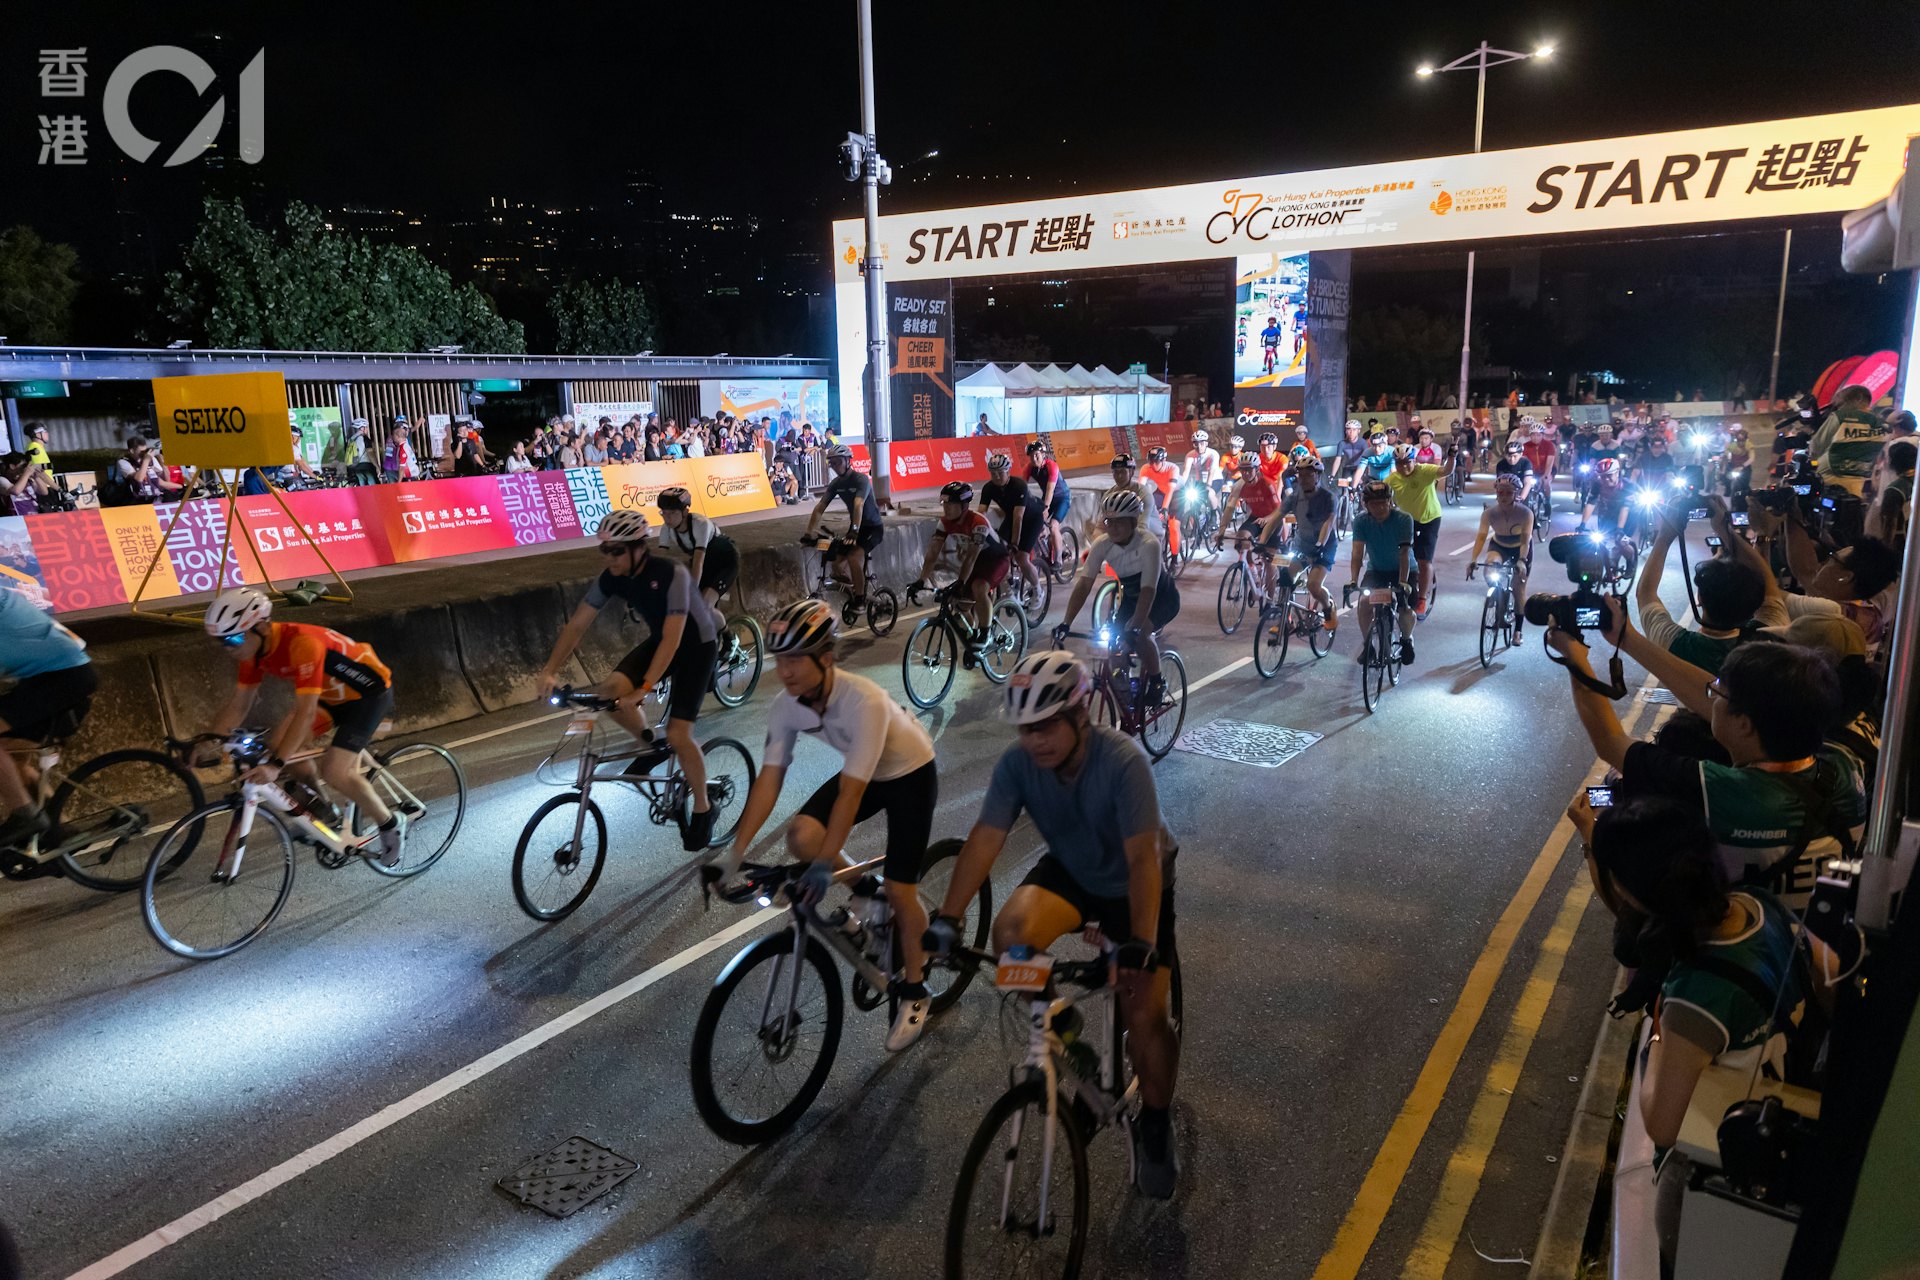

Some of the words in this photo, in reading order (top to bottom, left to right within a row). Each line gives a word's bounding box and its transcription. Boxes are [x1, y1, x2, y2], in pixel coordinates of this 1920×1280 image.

[1745, 135, 1869, 195] 起點
[1527, 147, 1749, 214] START
[1266, 194, 1281, 204] Sun
[1284, 192, 1306, 203] Hung
[1309, 189, 1323, 199] Kai
[1325, 185, 1371, 199] Properties
[1278, 203, 1304, 213] HONG
[1305, 201, 1330, 210] KONG
[1030, 212, 1095, 254] 起點
[906, 219, 1029, 265] START
[894, 297, 927, 314] READY,
[929, 300, 947, 316] SET,
[1315, 297, 1348, 317] TUNNELS
[903, 317, 938, 334] 各就各位
[907, 341, 934, 353] CHEER
[913, 393, 932, 407] 只在
[173, 406, 246, 435] SEIKO
[913, 408, 933, 428] 香港
[914, 428, 933, 437] HONG
[544, 481, 566, 494] 只在
[547, 493, 570, 510] 香港
[552, 508, 573, 517] HONG
[554, 515, 575, 524] KONG
[115, 526, 140, 536] ONLY
[142, 525, 153, 533] IN
[440, 520, 456, 529] Hung
[466, 517, 493, 526] Properties
[118, 533, 158, 556] 香港
[320, 535, 333, 543] Kai
[333, 532, 366, 541] Properties
